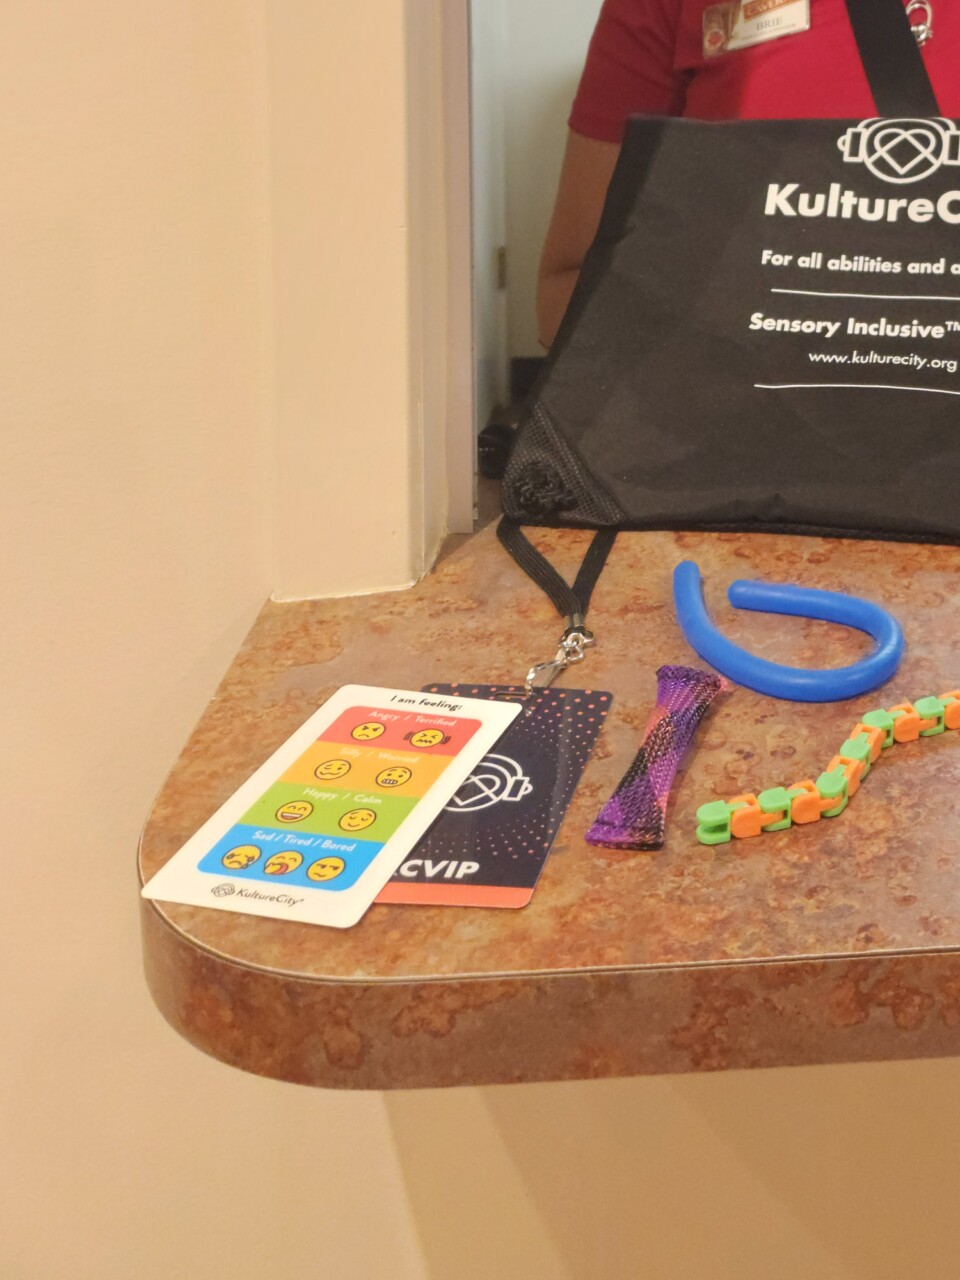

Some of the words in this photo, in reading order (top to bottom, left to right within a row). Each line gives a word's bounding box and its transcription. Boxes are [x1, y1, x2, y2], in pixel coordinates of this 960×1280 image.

[756, 17, 783, 31] BRIE
[761, 250, 793, 266] For
[797, 252, 822, 269] all
[827, 255, 901, 274] abilities
[907, 258, 945, 275] and
[749, 313, 841, 337] Sensory
[808, 351, 958, 373] www.kulturecity.org
[418, 698, 463, 711] feeling:
[369, 710, 400, 722] Angry
[415, 714, 458, 727] Terrified
[302, 787, 338, 800] Happy
[354, 793, 382, 804] Calm
[252, 830, 277, 841] Sad
[283, 834, 313, 847] Tired
[321, 839, 357, 852] Bored
[394, 859, 480, 879] CVIP
